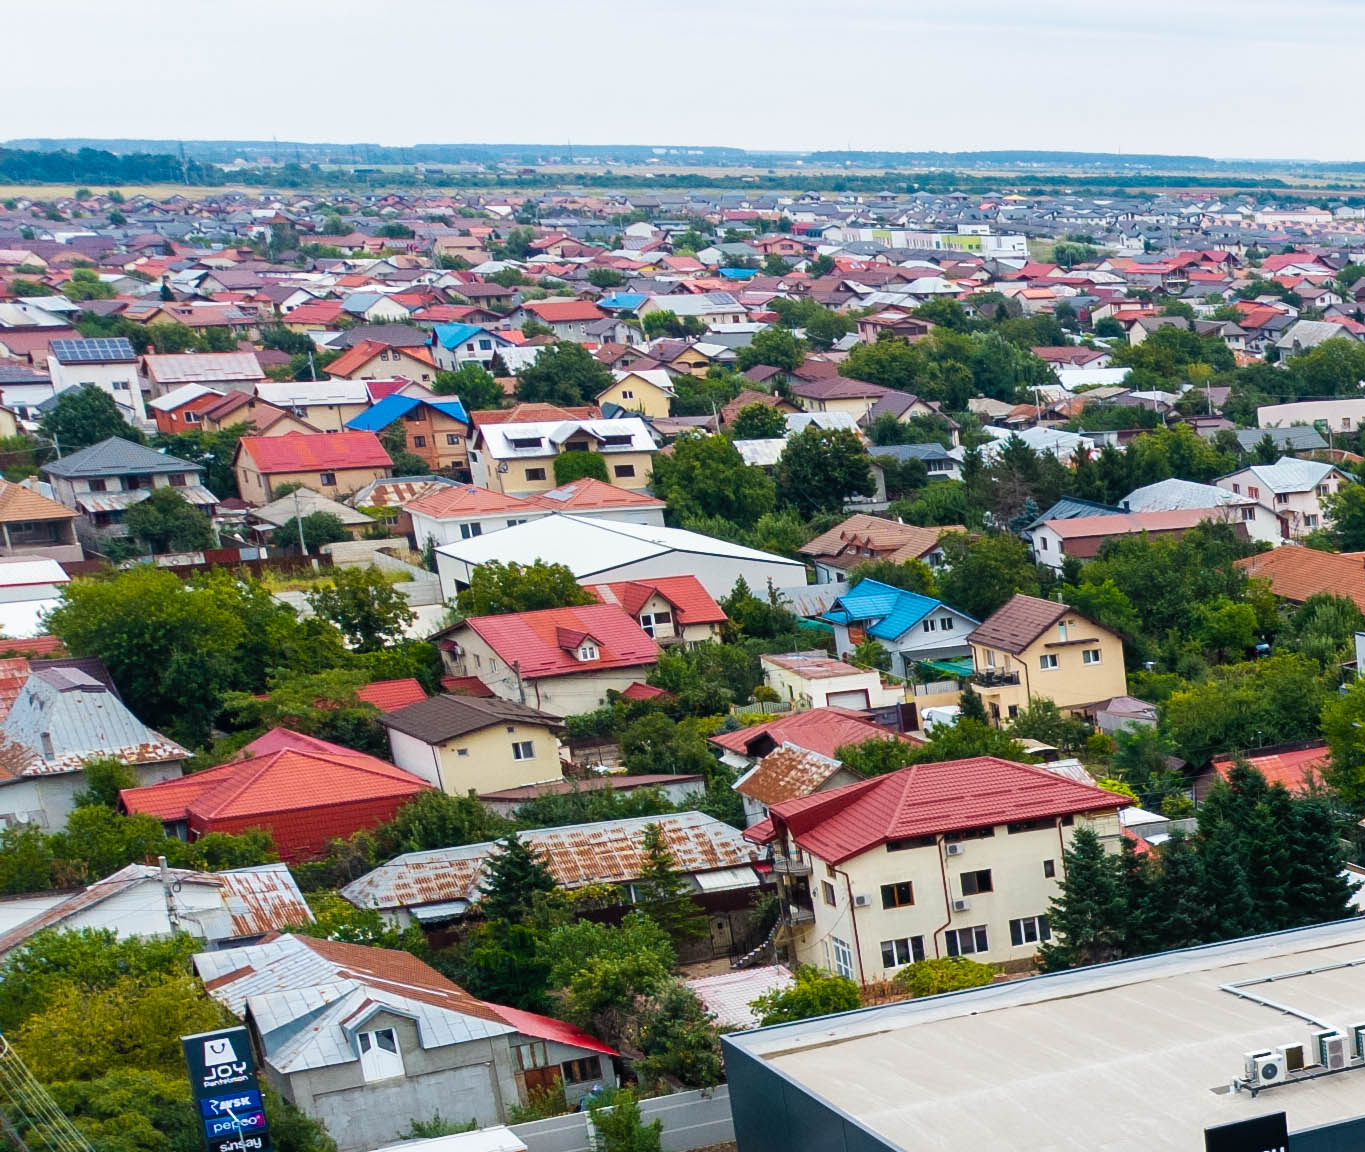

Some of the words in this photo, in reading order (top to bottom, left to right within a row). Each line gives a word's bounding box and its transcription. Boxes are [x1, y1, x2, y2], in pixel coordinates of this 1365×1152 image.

[203, 1062, 247, 1081] JOY
[213, 1116, 258, 1134] pepco
[219, 1137, 262, 1152] sinsay
